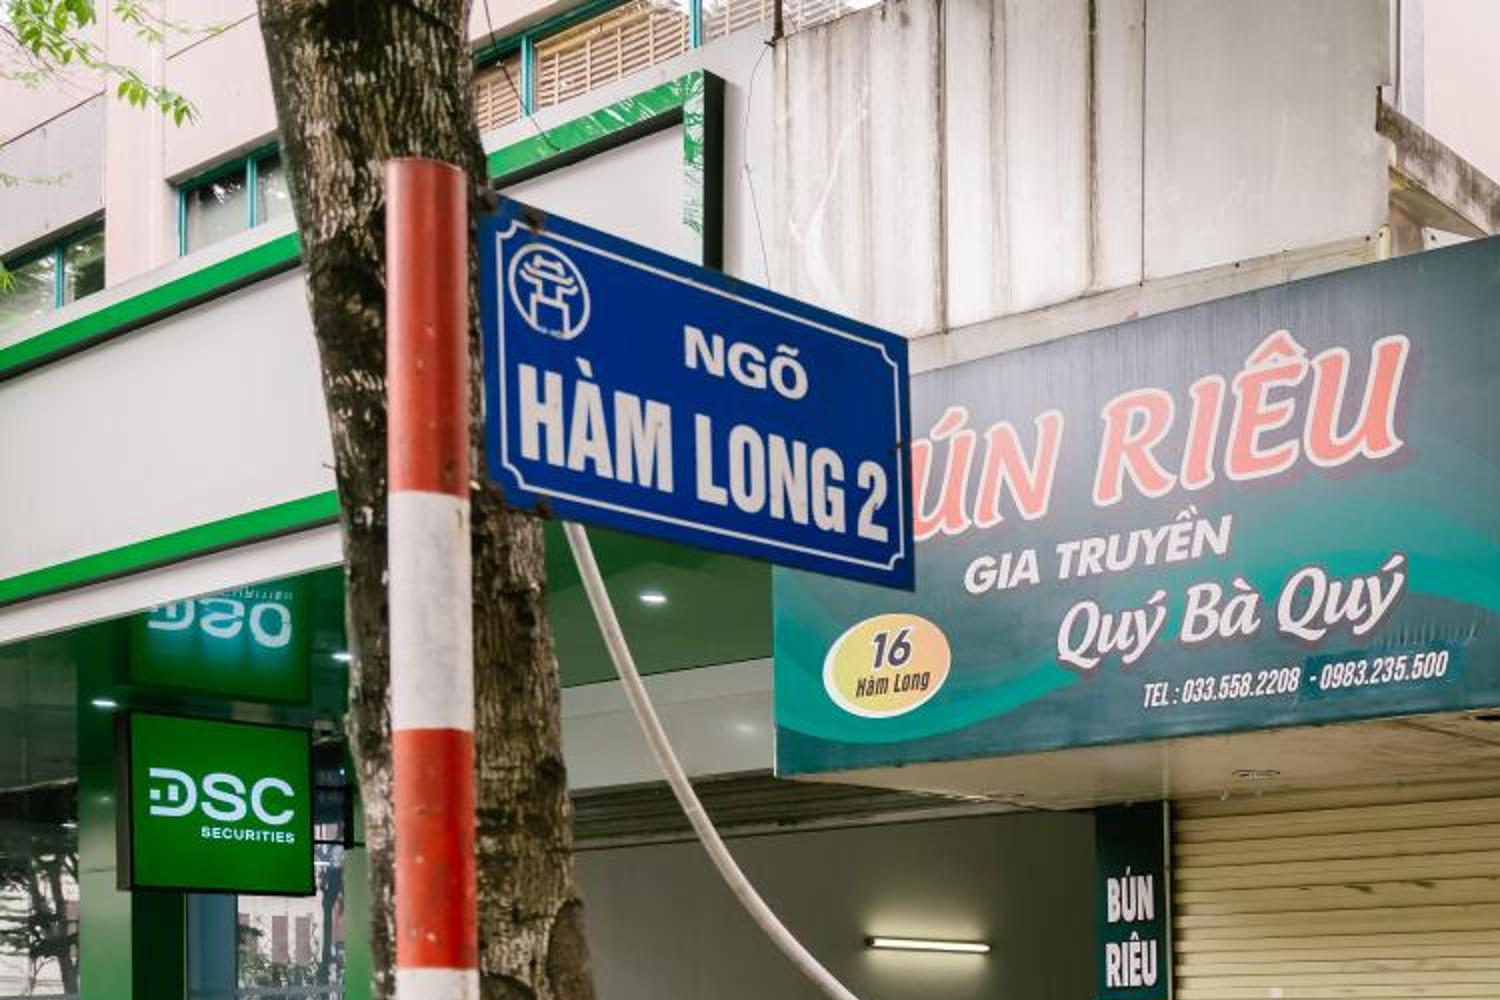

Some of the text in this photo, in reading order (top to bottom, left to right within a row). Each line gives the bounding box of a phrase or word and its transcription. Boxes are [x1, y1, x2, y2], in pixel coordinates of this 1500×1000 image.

[684, 324, 809, 400] NGÕ
[517, 356, 889, 543] HÀM LONG 2
[912, 329, 1409, 543] ÚN RIÊU
[964, 505, 1233, 595] GIA TRUYỀN
[1056, 554, 1406, 669] Quý Bà Quý
[873, 629, 911, 669] 16
[1181, 667, 1300, 704] 033.558.2208
[1320, 650, 1449, 690] 0983.235.500
[855, 671, 931, 698] Hàm Long
[149, 767, 295, 825] DSC
[201, 826, 295, 844] SECURITIES
[1107, 866, 1154, 923] BÚN
[1105, 931, 1157, 987] RIÊU
